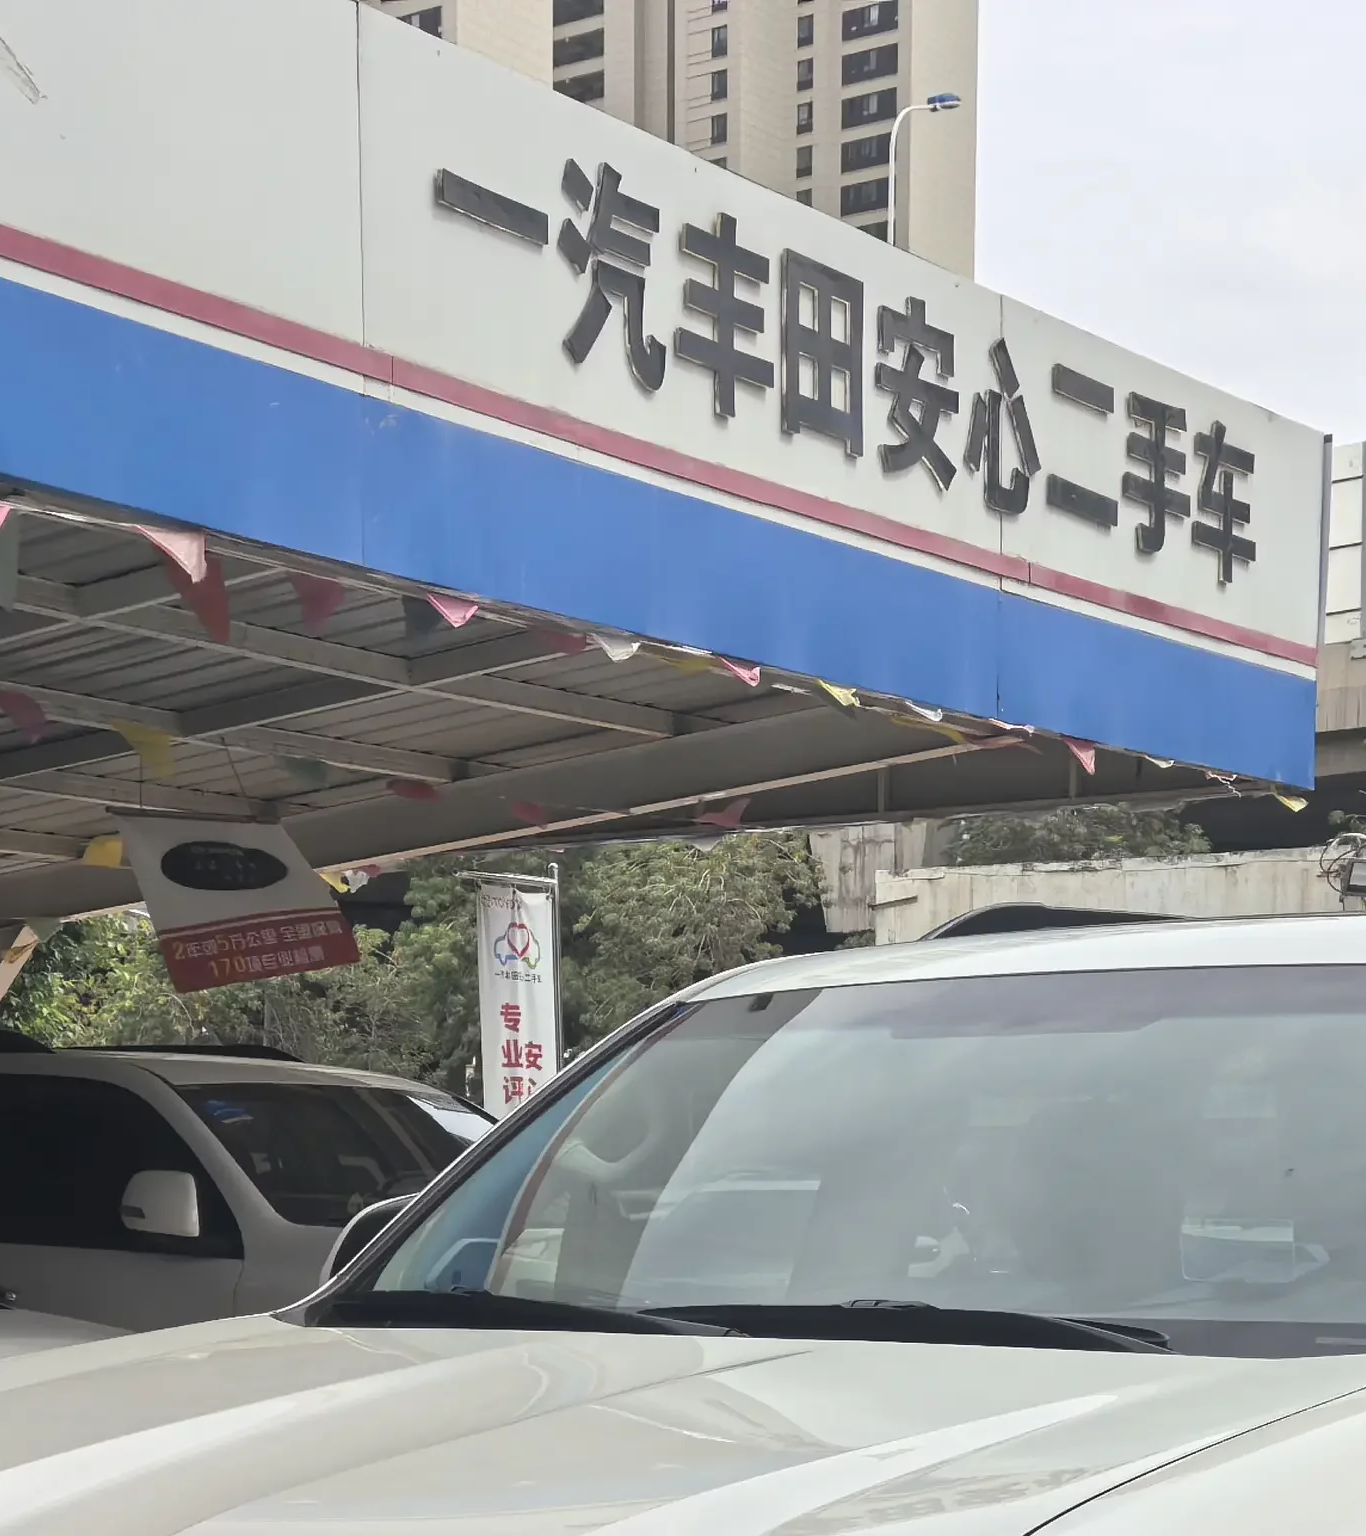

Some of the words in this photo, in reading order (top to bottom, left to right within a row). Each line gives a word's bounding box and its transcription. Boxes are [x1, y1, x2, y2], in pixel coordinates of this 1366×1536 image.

[435, 157, 1257, 585] 一汽丰田安心二手车
